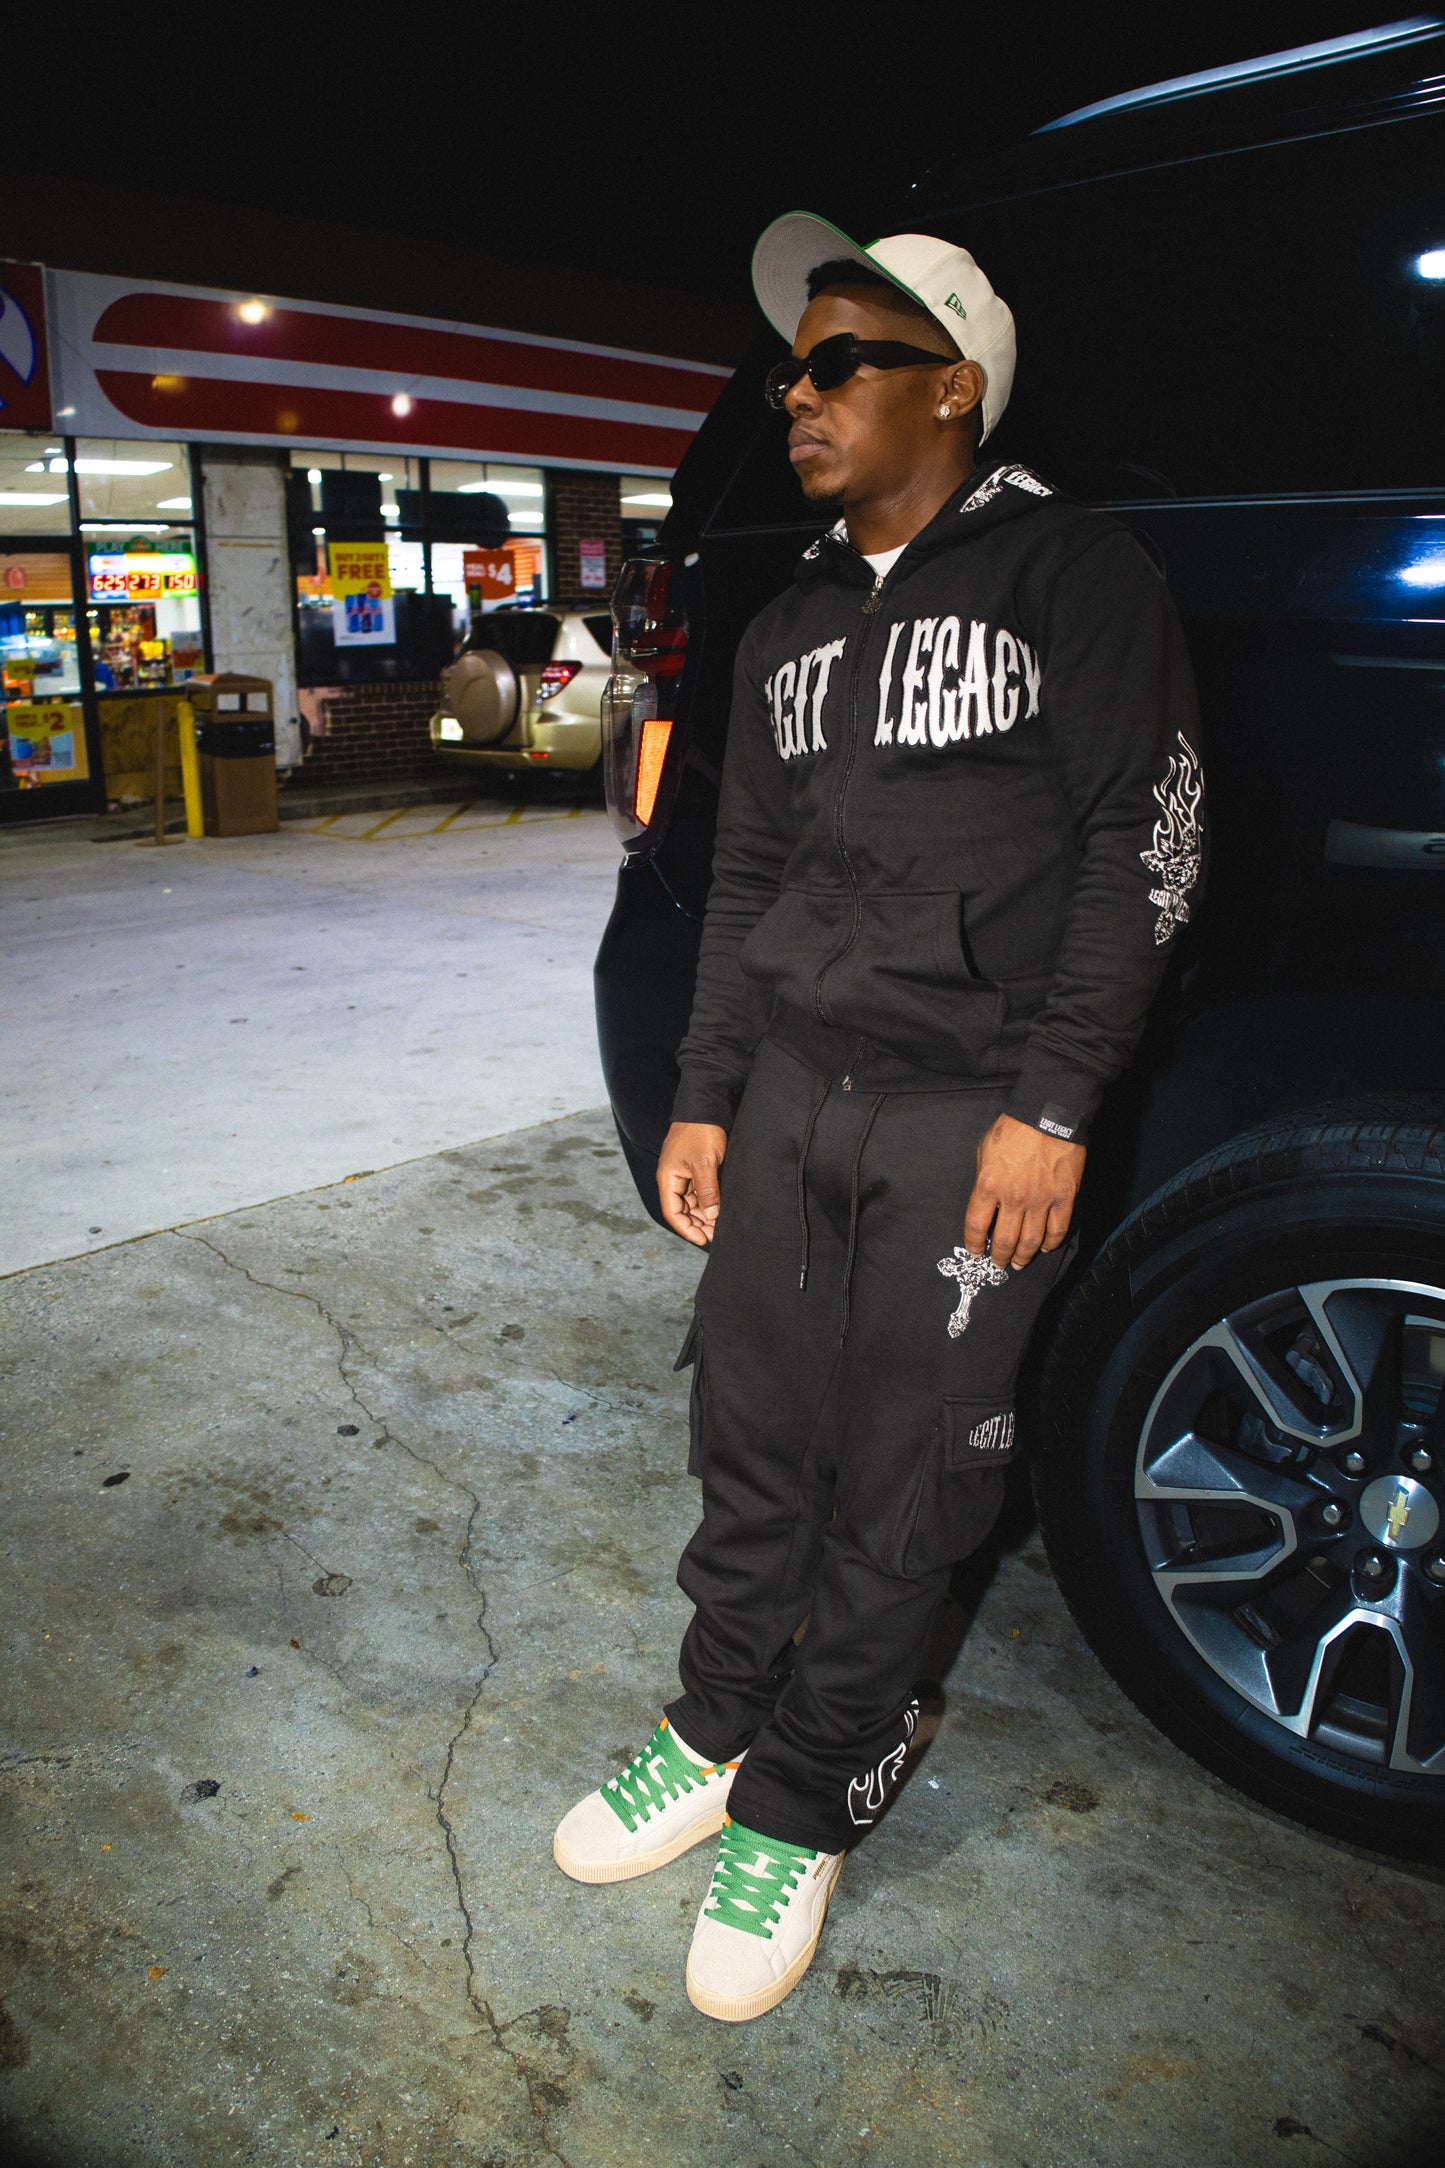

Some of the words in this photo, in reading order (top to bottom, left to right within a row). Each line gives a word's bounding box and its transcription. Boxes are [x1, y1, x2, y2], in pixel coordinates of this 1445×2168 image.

[337, 564, 386, 580] FREE
[487, 563, 513, 585] $4
[93, 574, 126, 591] 625
[128, 574, 161, 590] 273
[168, 574, 195, 589] 150
[765, 636, 847, 761] GIT
[873, 615, 1042, 749] LEGACY
[43, 711, 65, 731] $2
[1039, 1117, 1056, 1129] LEGIT
[968, 1413, 1001, 1450] LEGIT
[998, 1411, 1016, 1450] LE
